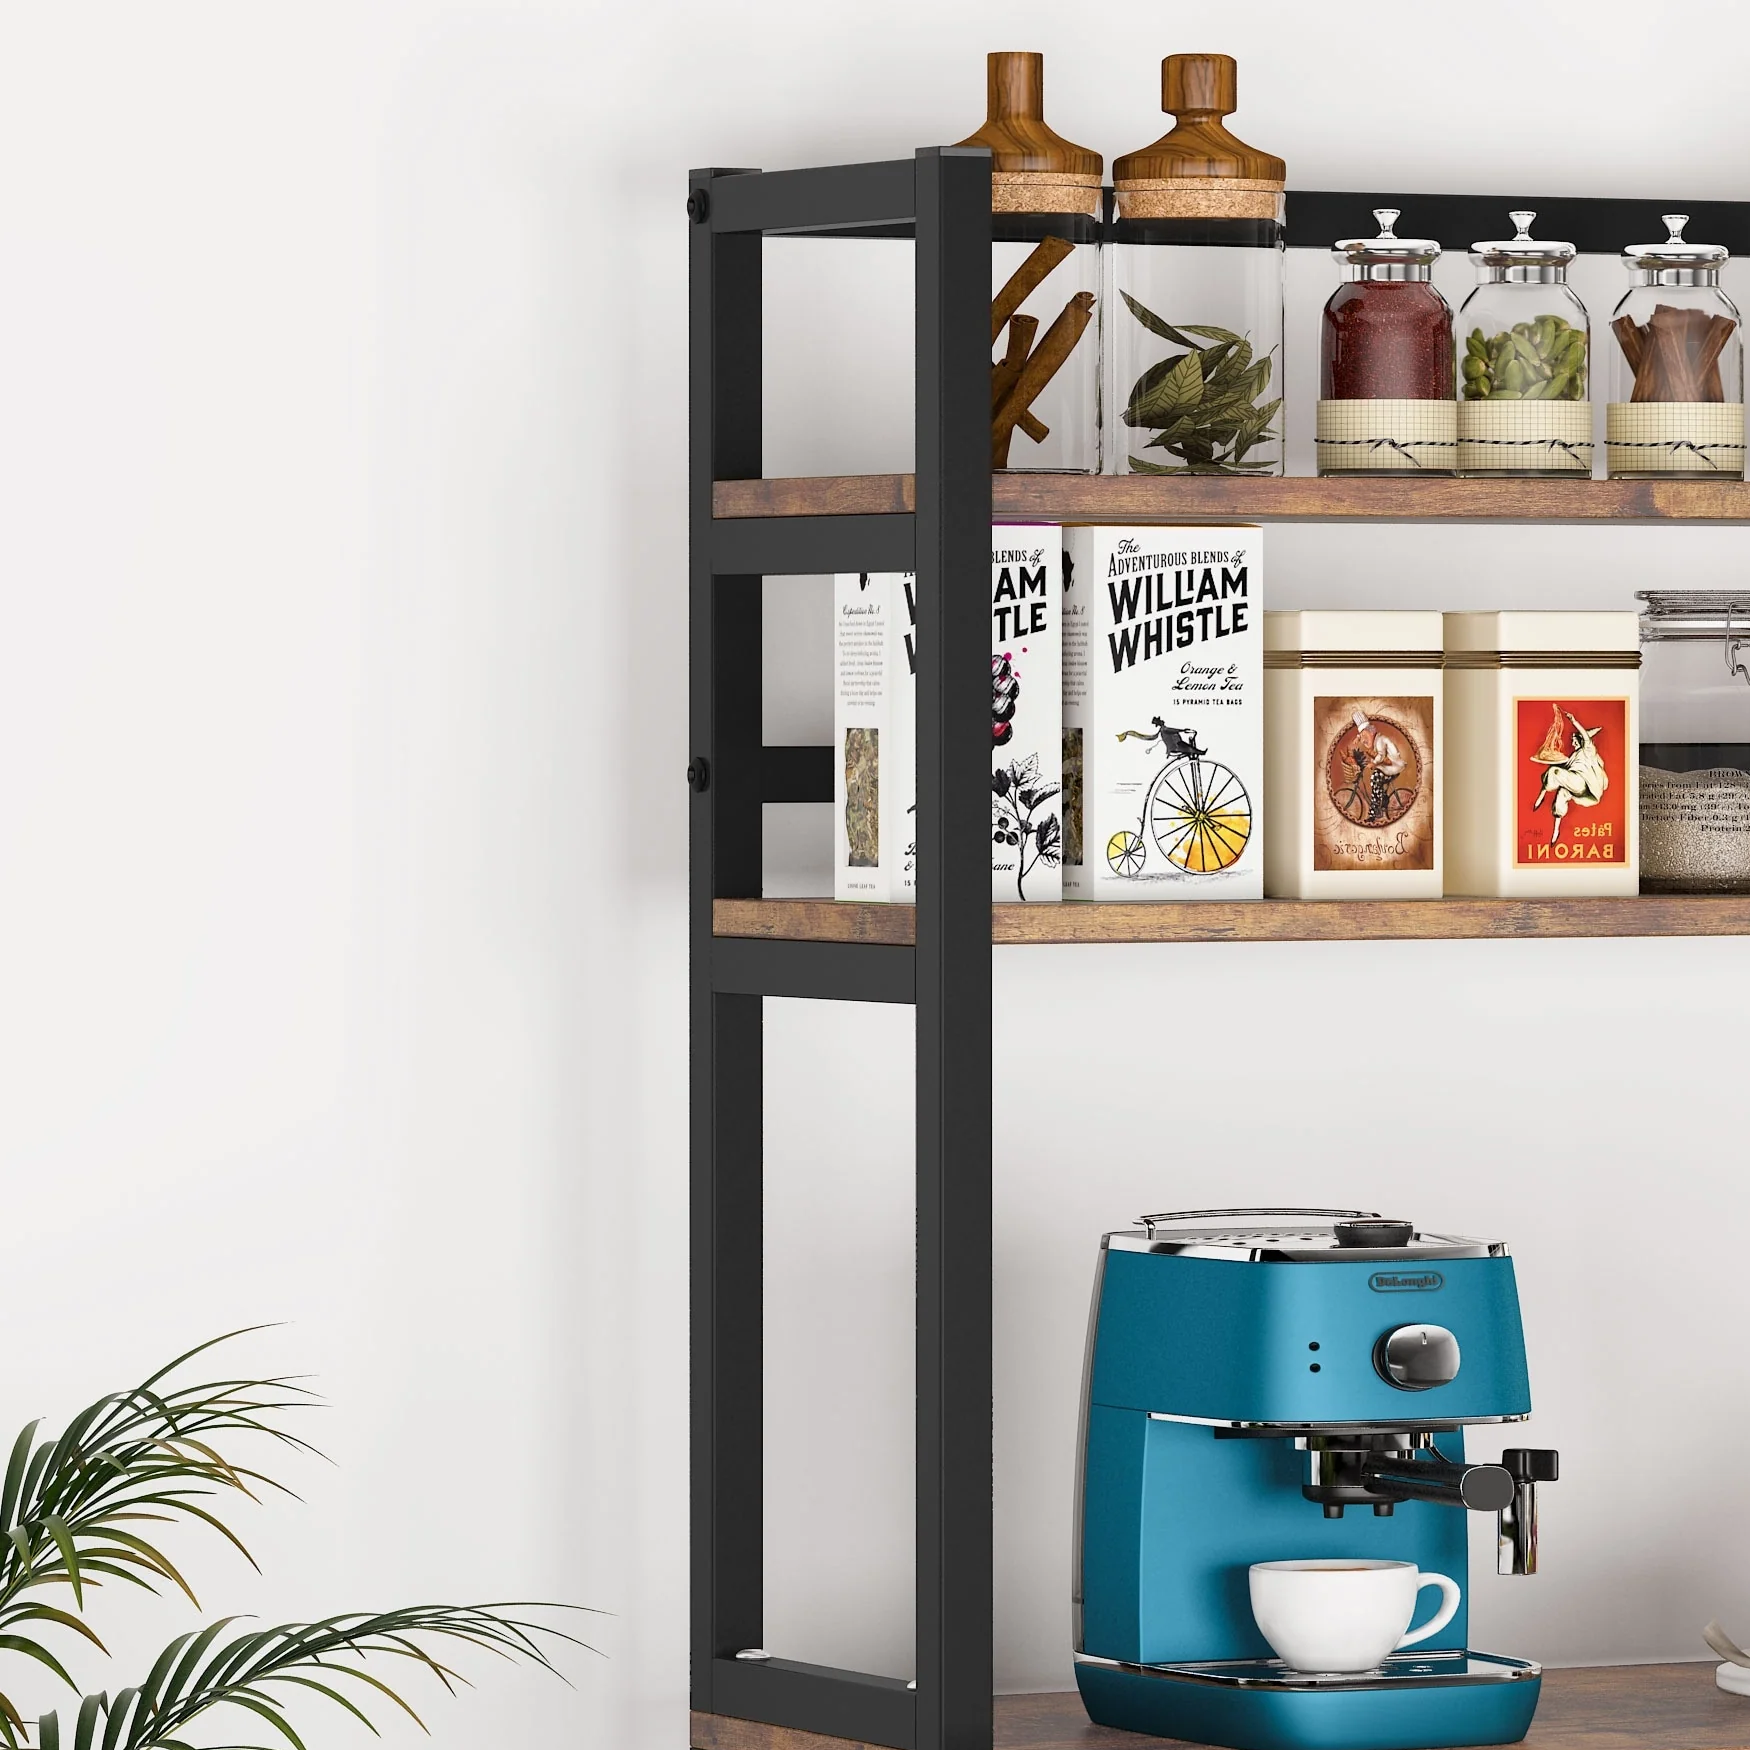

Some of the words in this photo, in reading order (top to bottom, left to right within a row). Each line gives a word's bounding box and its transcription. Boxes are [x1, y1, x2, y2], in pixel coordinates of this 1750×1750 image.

[1118, 538, 1140, 555] The
[1108, 552, 1187, 577] ADVENTUROUS
[1191, 551, 1229, 564] BLENDS
[1231, 550, 1246, 569] of
[1108, 567, 1248, 625] WILLIAM
[1108, 602, 1248, 674] WHISTLE
[1180, 661, 1225, 679] Orange
[1227, 664, 1237, 674] &
[1172, 677, 1216, 690] Lemon
[1220, 676, 1243, 690] Tea
